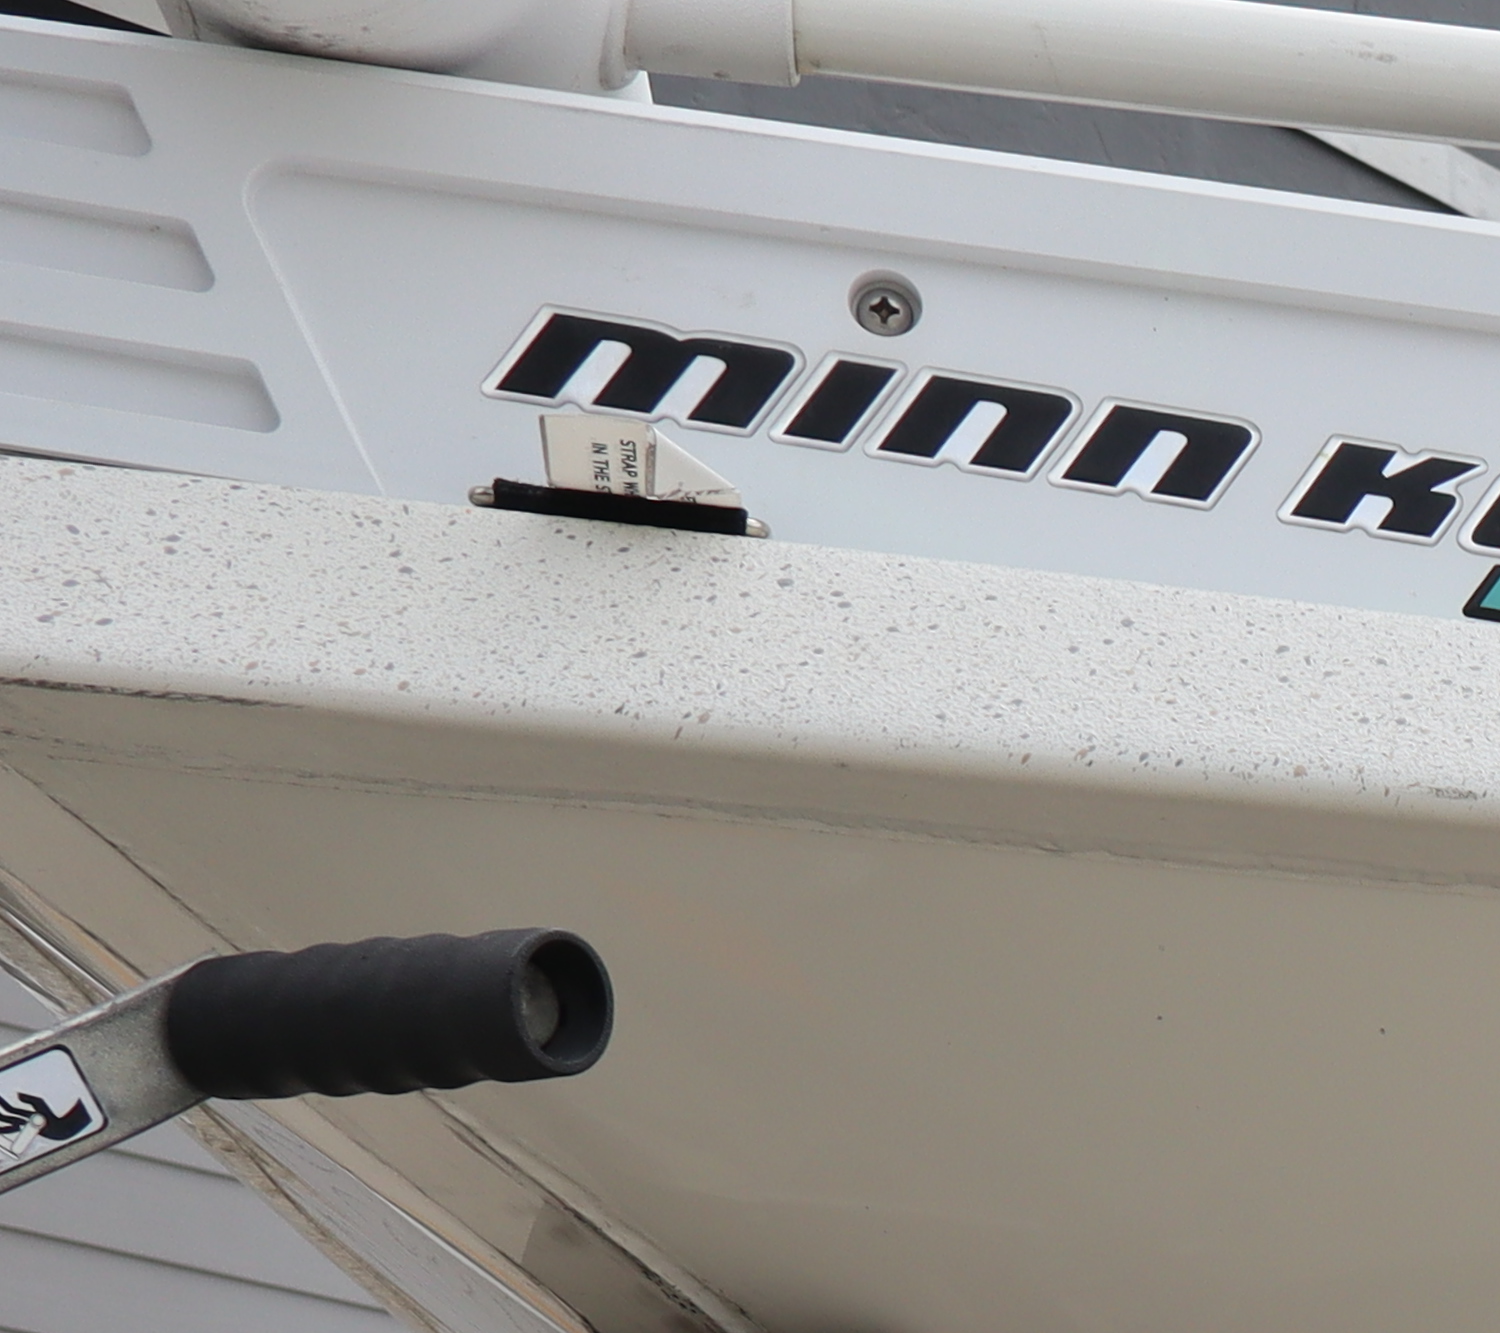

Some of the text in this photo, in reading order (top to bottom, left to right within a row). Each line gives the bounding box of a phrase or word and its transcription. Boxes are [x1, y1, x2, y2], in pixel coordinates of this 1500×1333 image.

[592, 442, 609, 456] IN
[619, 439, 638, 478] STRAP
[592, 459, 611, 482] THE
